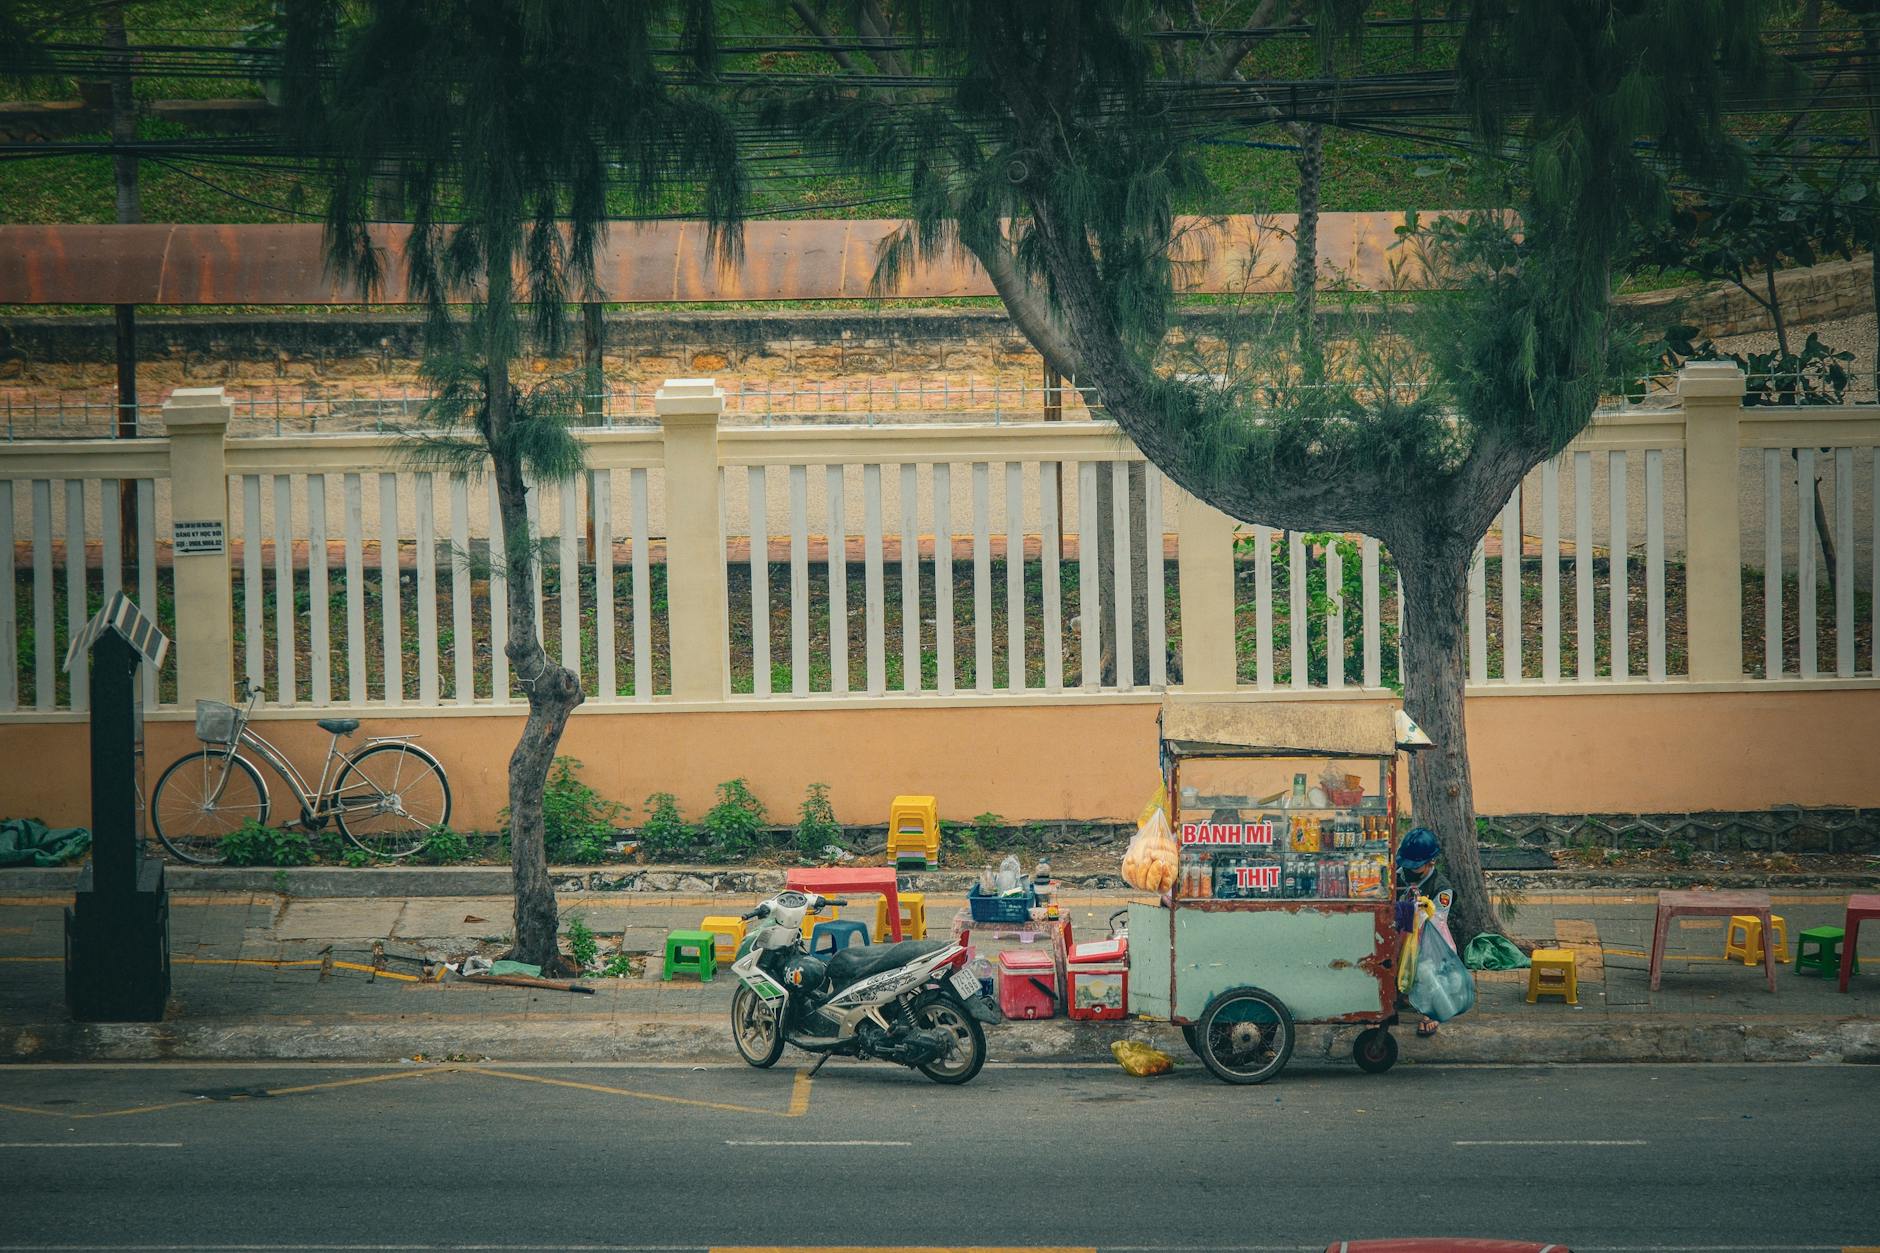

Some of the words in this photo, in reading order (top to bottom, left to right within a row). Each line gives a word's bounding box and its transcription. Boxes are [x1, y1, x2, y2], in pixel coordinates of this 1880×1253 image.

[1183, 820, 1242, 844] BÁNH
[1246, 820, 1273, 844] MÌ
[1235, 867, 1280, 891] THỊT
